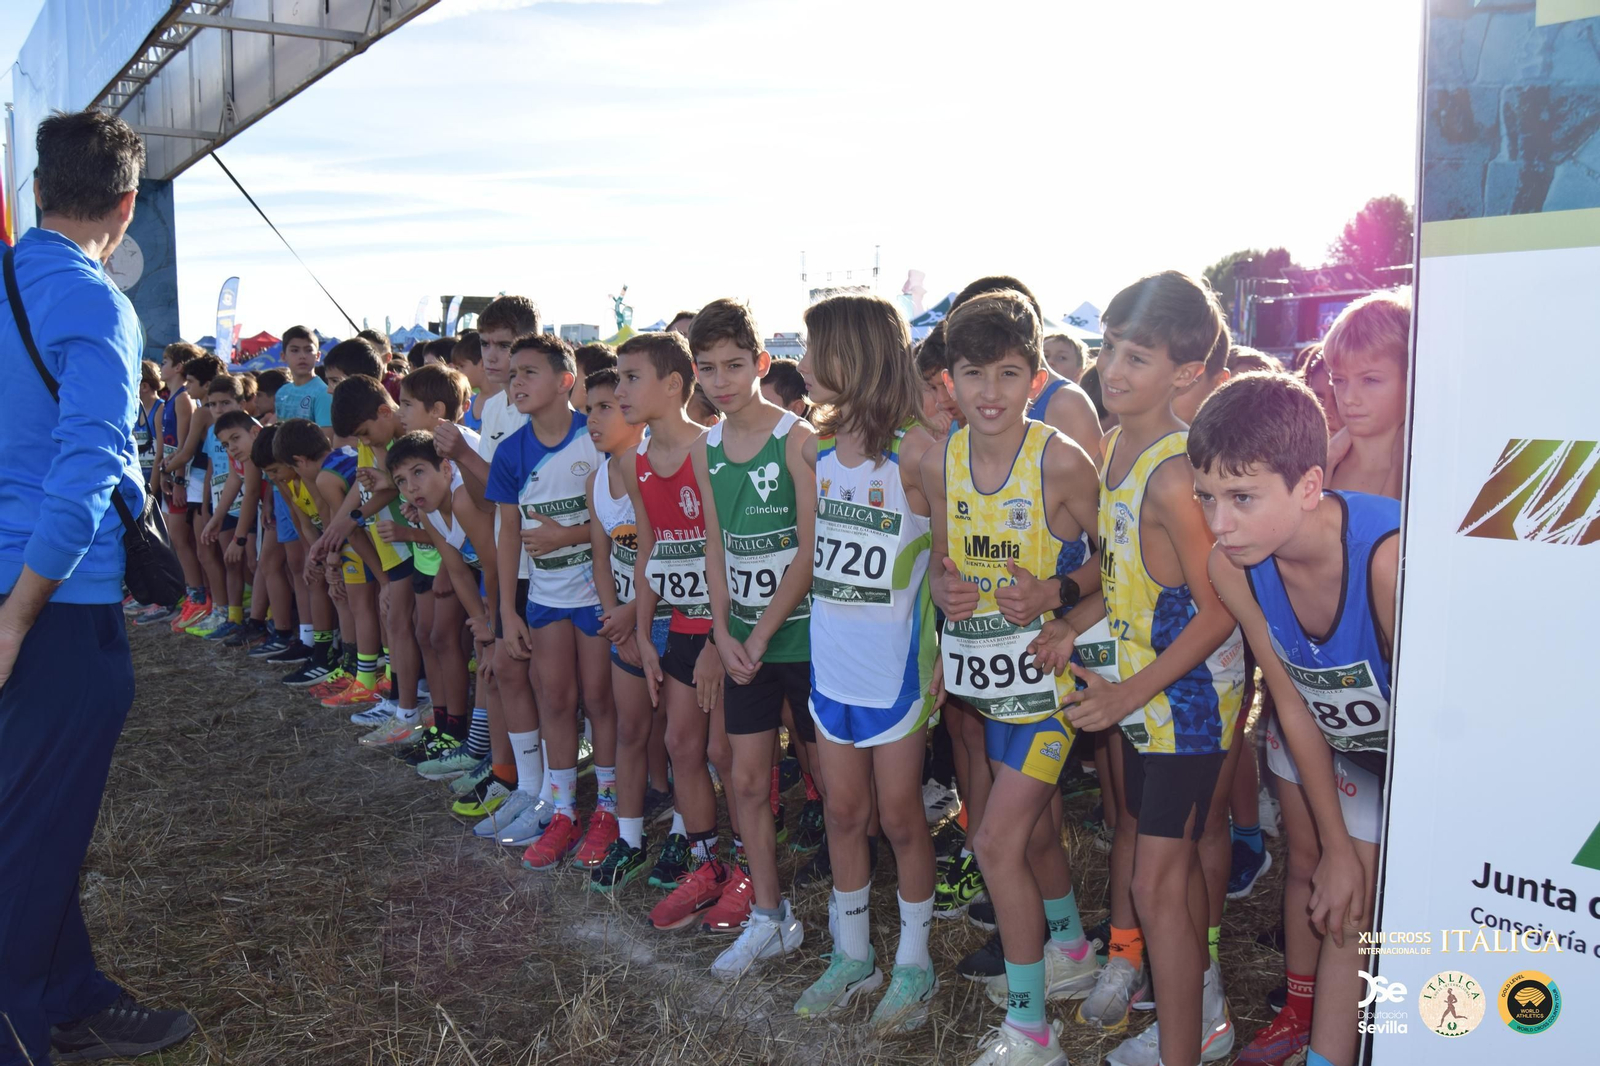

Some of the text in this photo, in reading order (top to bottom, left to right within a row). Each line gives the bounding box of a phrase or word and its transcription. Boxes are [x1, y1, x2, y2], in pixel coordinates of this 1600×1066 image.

[539, 499, 580, 514] ITÁLICA
[828, 502, 874, 523] ITÁLICA
[660, 542, 697, 555] ITÁLICA
[731, 538, 774, 550] ITÁLICA
[814, 535, 887, 580] 5720
[613, 570, 636, 598] 57
[729, 564, 790, 598] 579
[959, 617, 1010, 632] ITÁLICA
[949, 651, 1044, 690] 7896
[1287, 665, 1331, 685] LICA
[1310, 699, 1381, 730] 80
[1471, 862, 1578, 913] Junta
[845, 904, 868, 915] adid
[1469, 906, 1587, 954] Consejería
